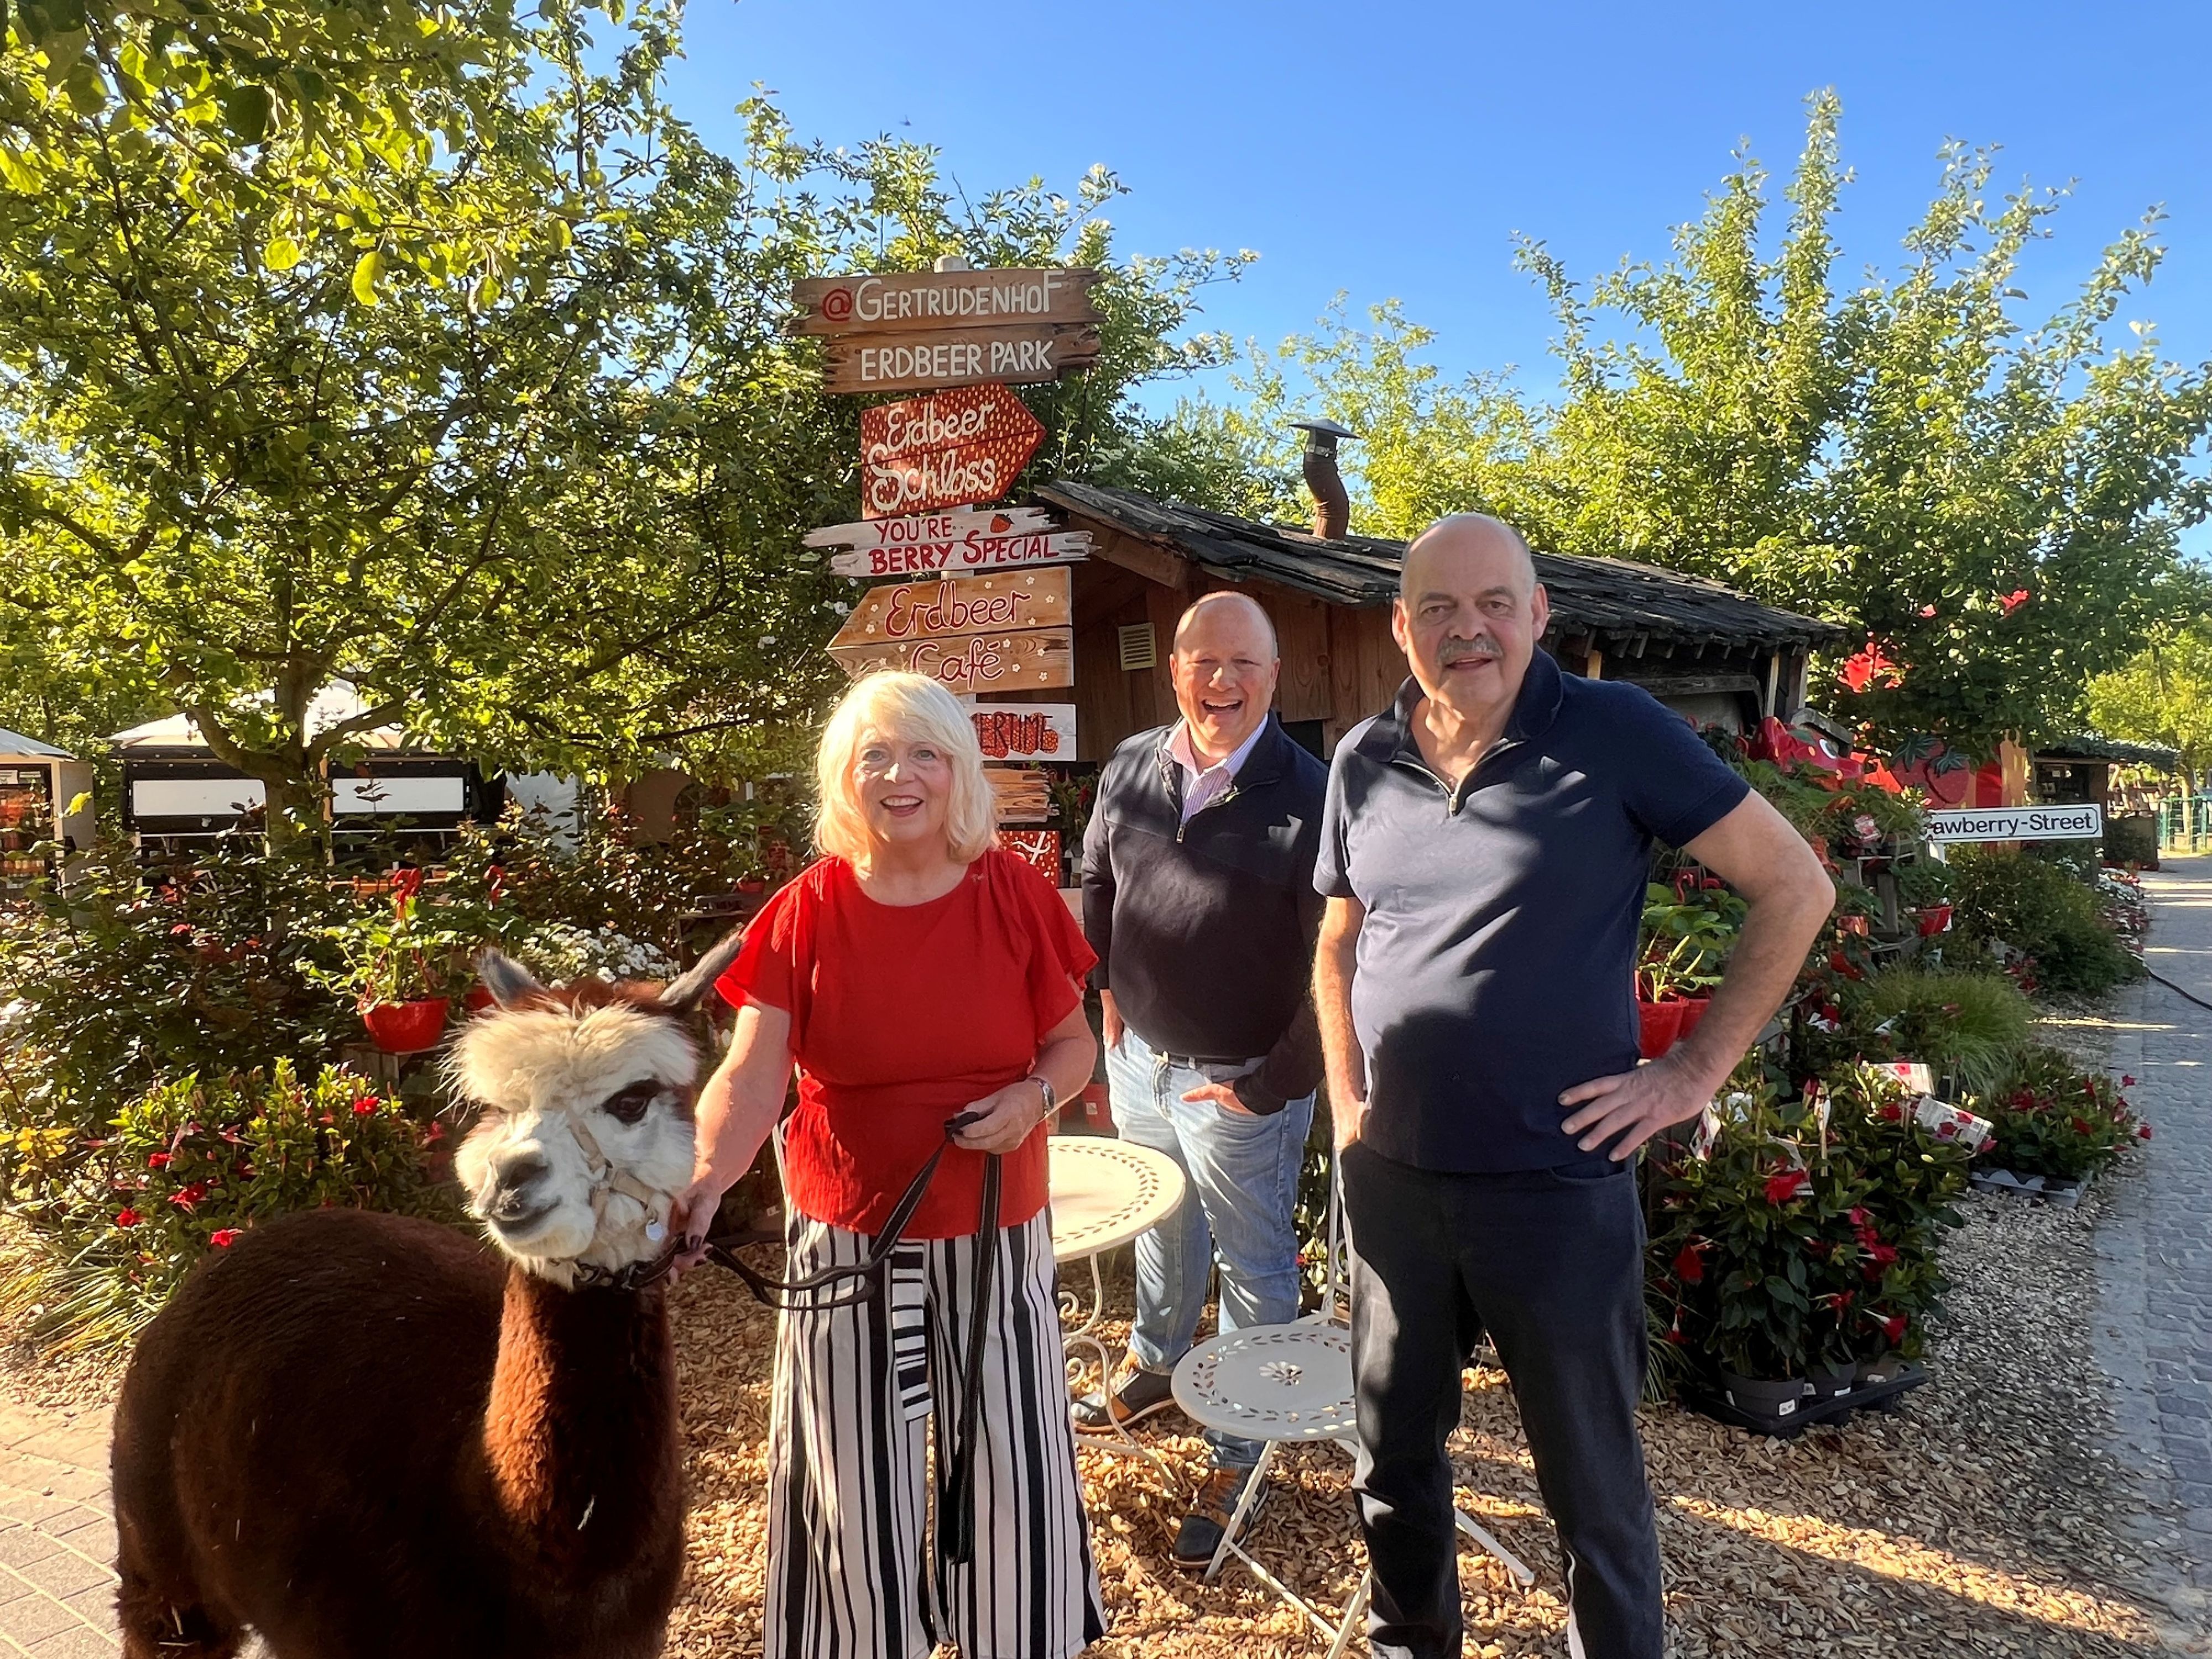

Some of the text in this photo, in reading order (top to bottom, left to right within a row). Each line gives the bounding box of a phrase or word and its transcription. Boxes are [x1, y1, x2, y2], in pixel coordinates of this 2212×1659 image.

[860, 340, 1053, 381] ERDBEER PARK
[886, 399, 995, 452] Erdbeer
[867, 442, 995, 511] Schloss
[868, 530, 1060, 574] BERRY SPECIAL
[874, 517, 953, 544] YOU'RE
[885, 581, 1032, 638] Erdbeer
[910, 637, 1005, 690] Café
[977, 711, 1053, 751] ERTIME
[1933, 812, 2094, 836] awberry-Street
